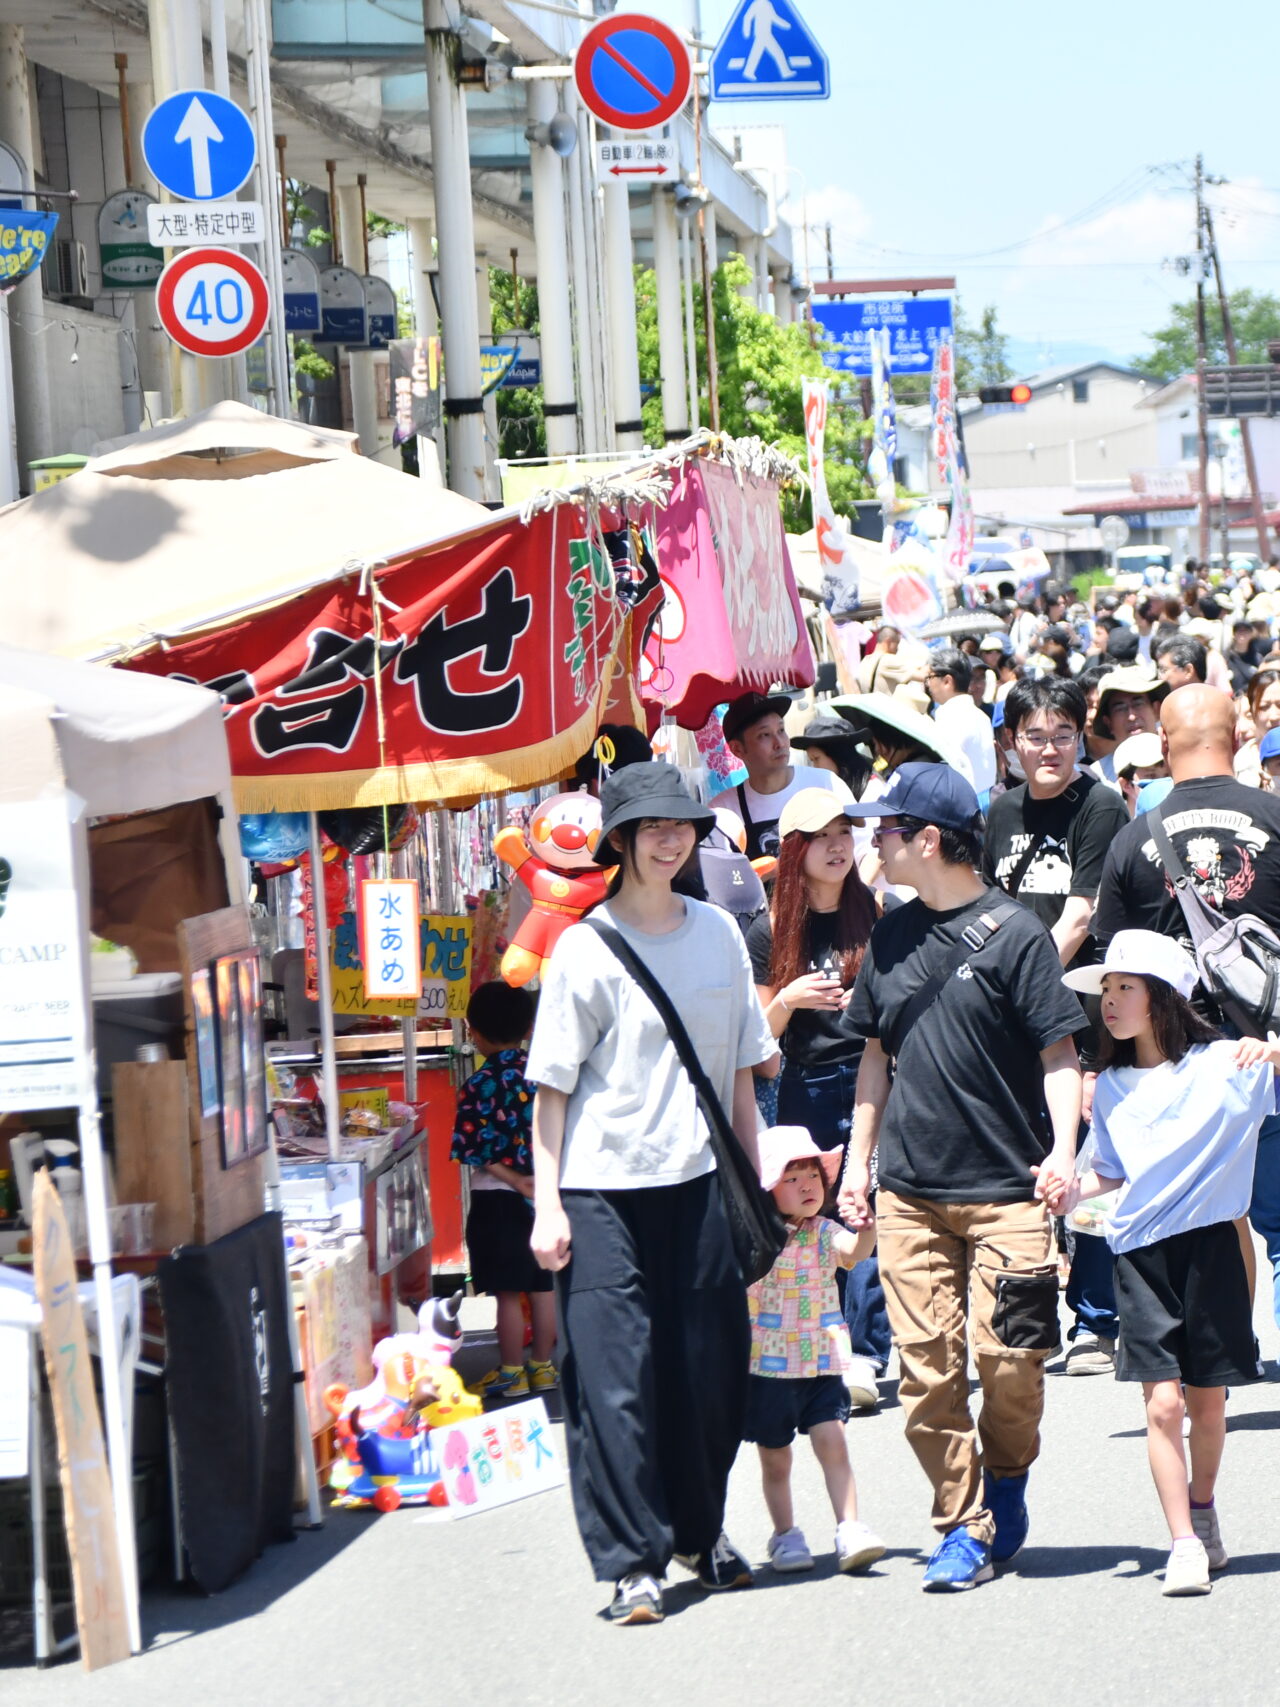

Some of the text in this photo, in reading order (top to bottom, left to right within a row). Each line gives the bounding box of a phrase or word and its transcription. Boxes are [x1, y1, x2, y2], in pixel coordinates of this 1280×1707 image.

[0, 225, 46, 249] e're
[157, 211, 256, 238] 大型・特定中型
[186, 279, 243, 325] 40
[863, 303, 905, 315] 市役所
[378, 891, 406, 984] 水あめ
